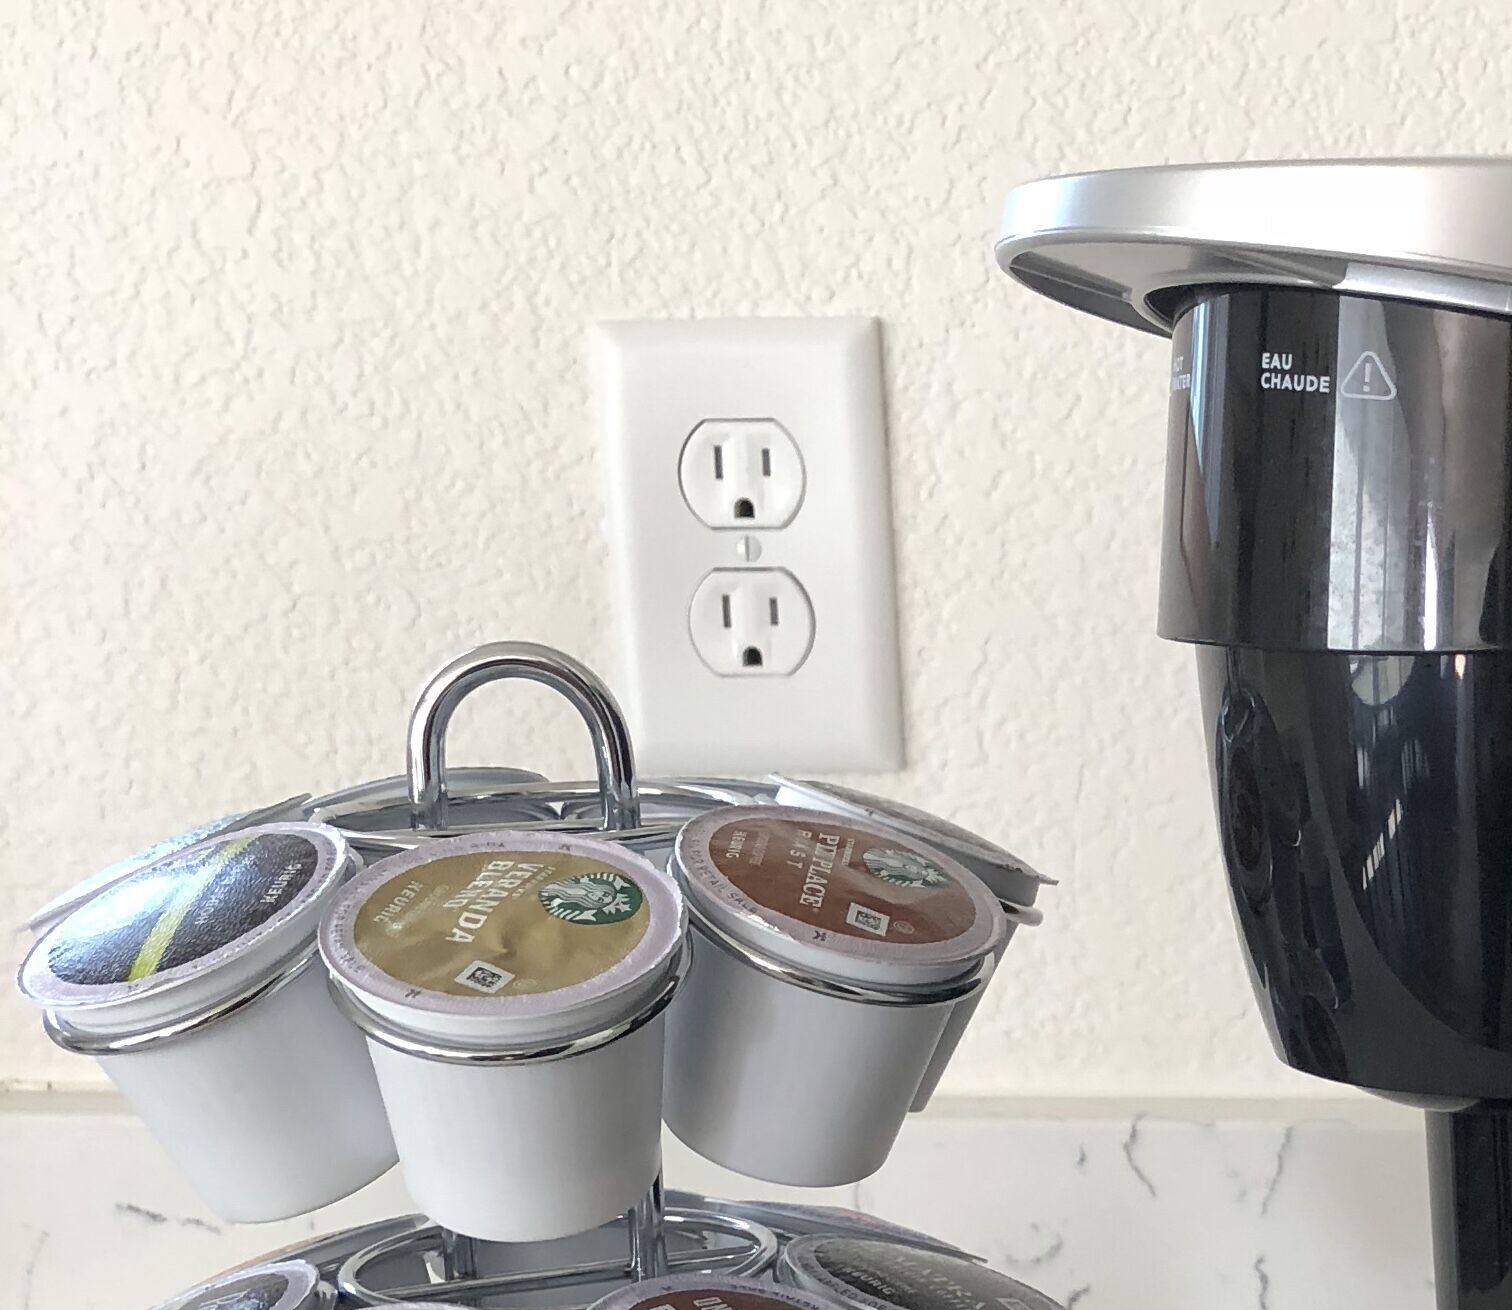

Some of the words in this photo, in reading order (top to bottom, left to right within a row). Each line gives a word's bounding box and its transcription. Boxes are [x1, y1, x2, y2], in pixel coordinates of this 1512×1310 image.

[1260, 373, 1331, 393] CHAUDE
[1261, 352, 1293, 370] EAU
[373, 880, 423, 922] KEURIG
[443, 860, 515, 908] BLEND
[445, 863, 544, 943] VERANDA
[800, 857, 833, 908] PLACE
